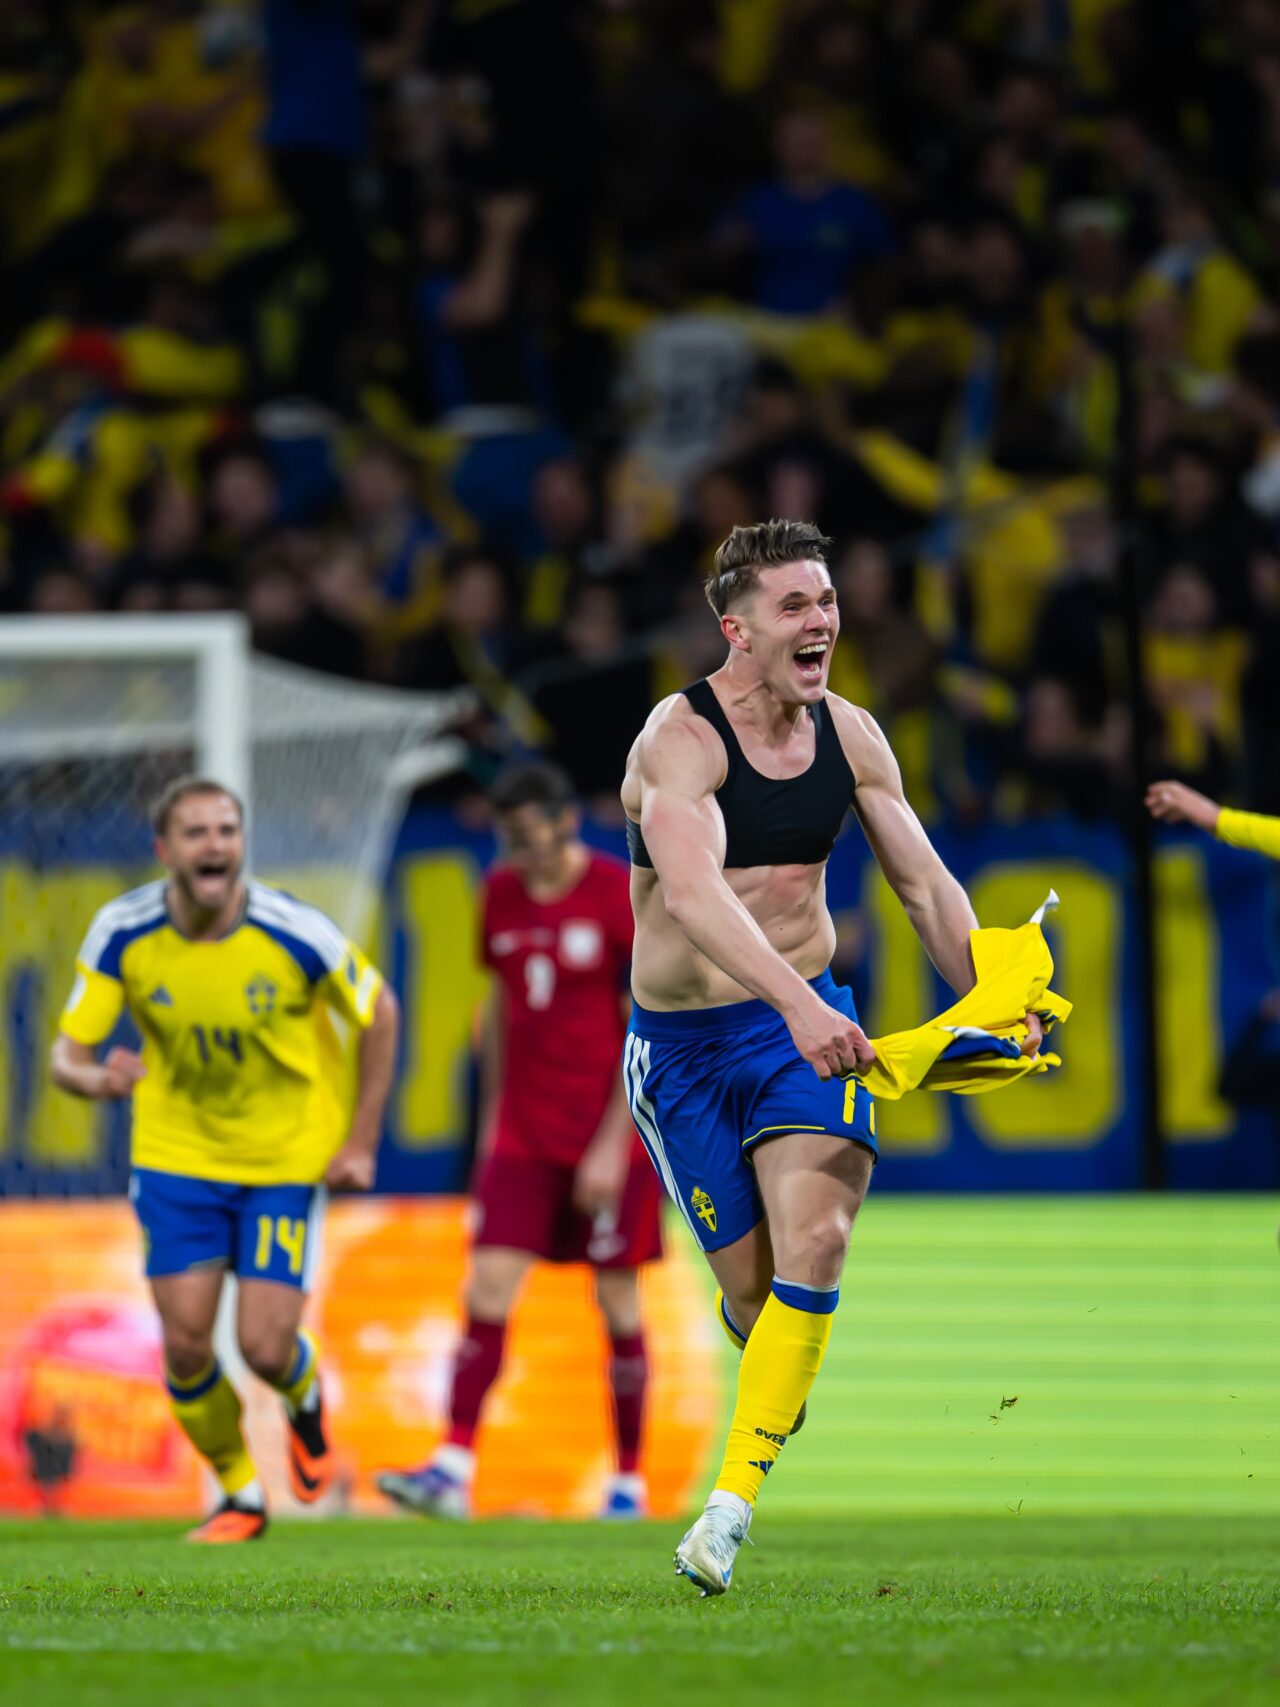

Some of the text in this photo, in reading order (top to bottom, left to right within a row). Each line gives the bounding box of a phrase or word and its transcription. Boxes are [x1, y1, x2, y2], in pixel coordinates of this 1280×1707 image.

[522, 949, 558, 1013] 9
[193, 1022, 245, 1064] 14
[255, 1213, 306, 1276] 14
